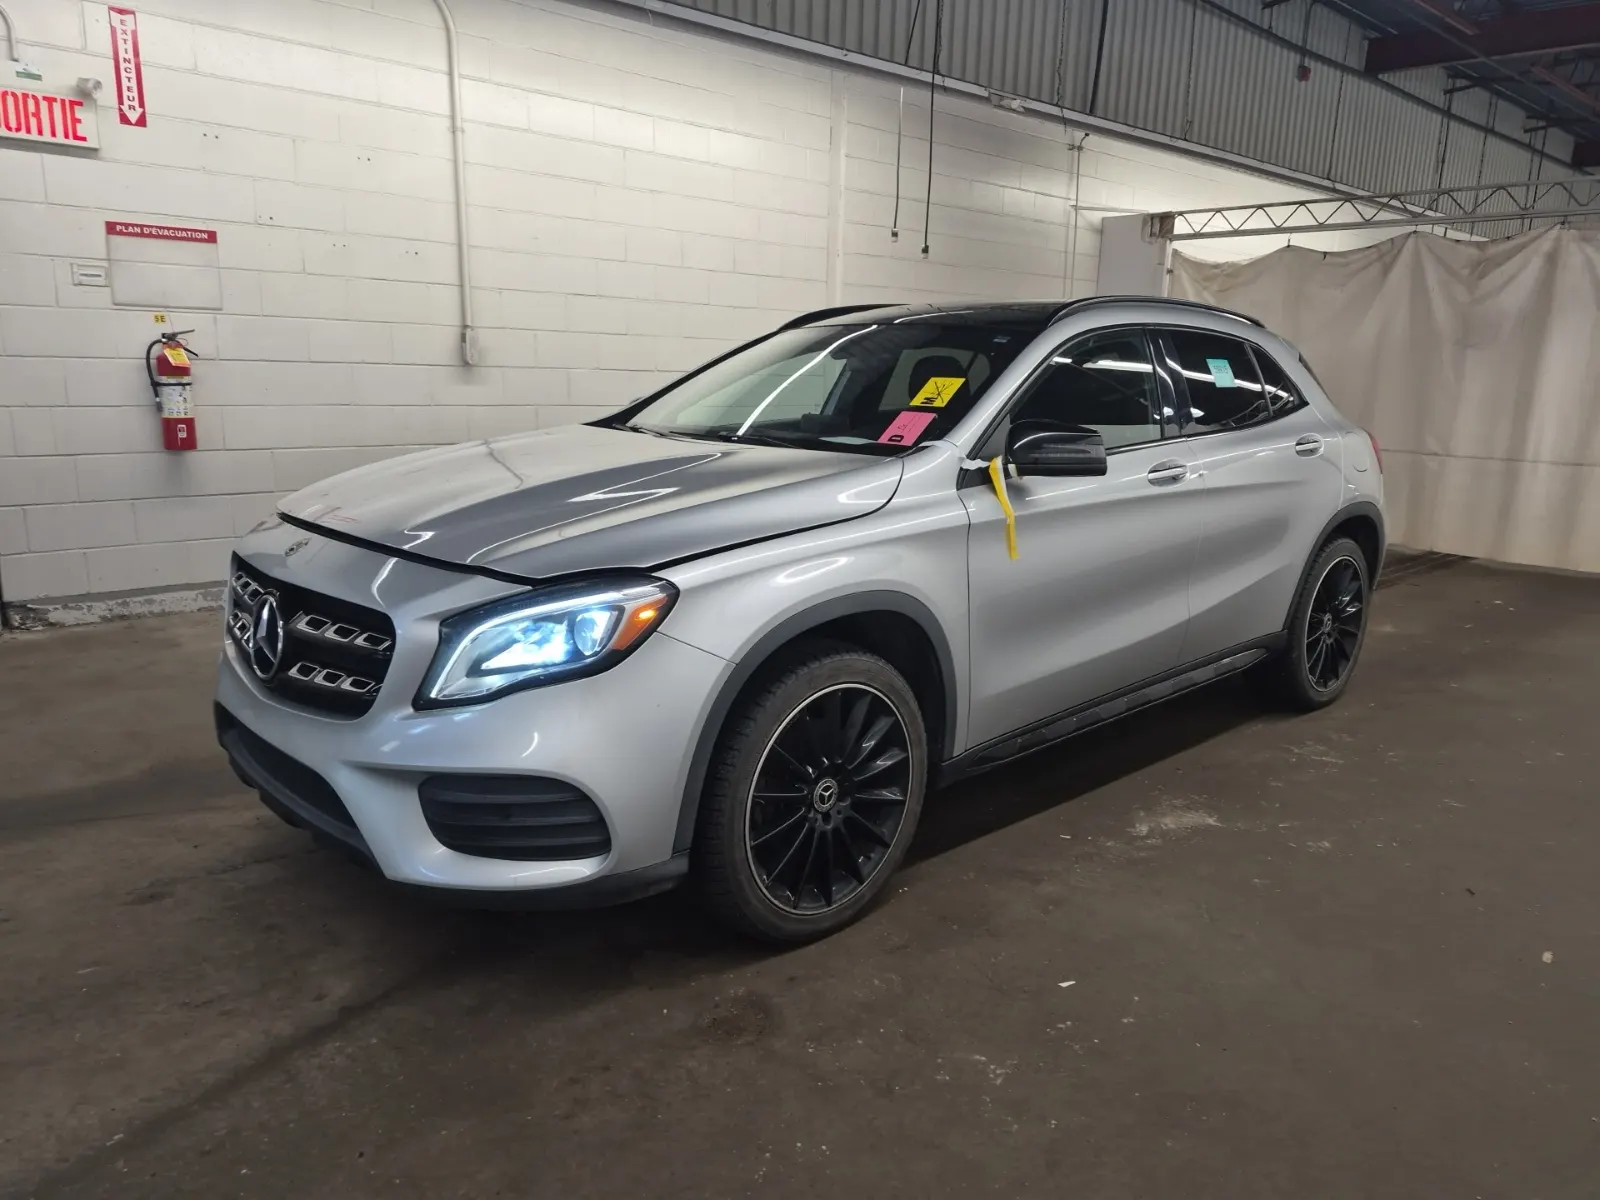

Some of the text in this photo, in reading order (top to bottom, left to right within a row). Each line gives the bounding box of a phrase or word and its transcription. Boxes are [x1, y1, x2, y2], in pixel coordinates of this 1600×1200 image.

[119, 18, 136, 112] EXTINCTEUR
[0, 90, 88, 142] ORTIE
[116, 224, 208, 239] PLAN D'ÉVACUATION
